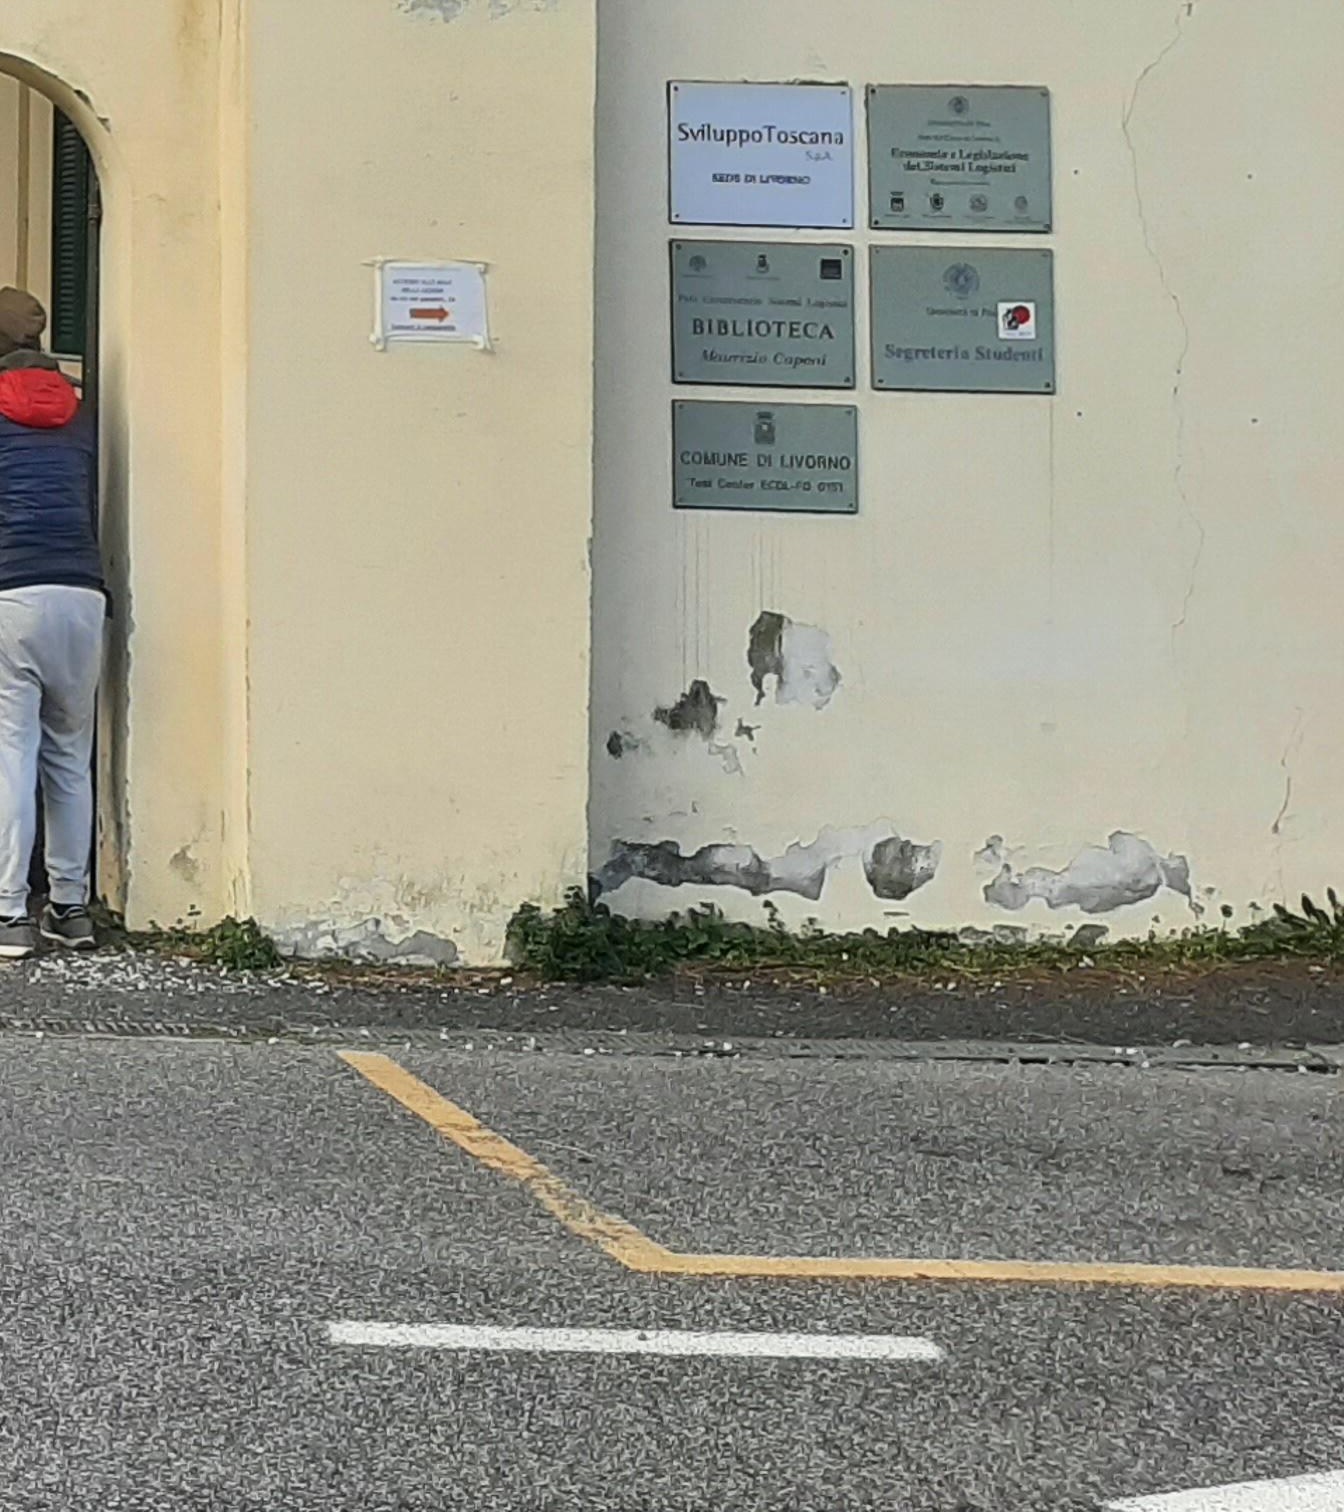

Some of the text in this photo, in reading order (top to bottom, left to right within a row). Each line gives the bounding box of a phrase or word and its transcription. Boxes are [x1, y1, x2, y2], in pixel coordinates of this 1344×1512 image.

[692, 317, 834, 339] BIBLIOTECA
[702, 349, 768, 365] Maurizio
[884, 344, 1044, 363] Segreteria Studenti
[680, 450, 851, 470] COMUNE DI LIVORNO
